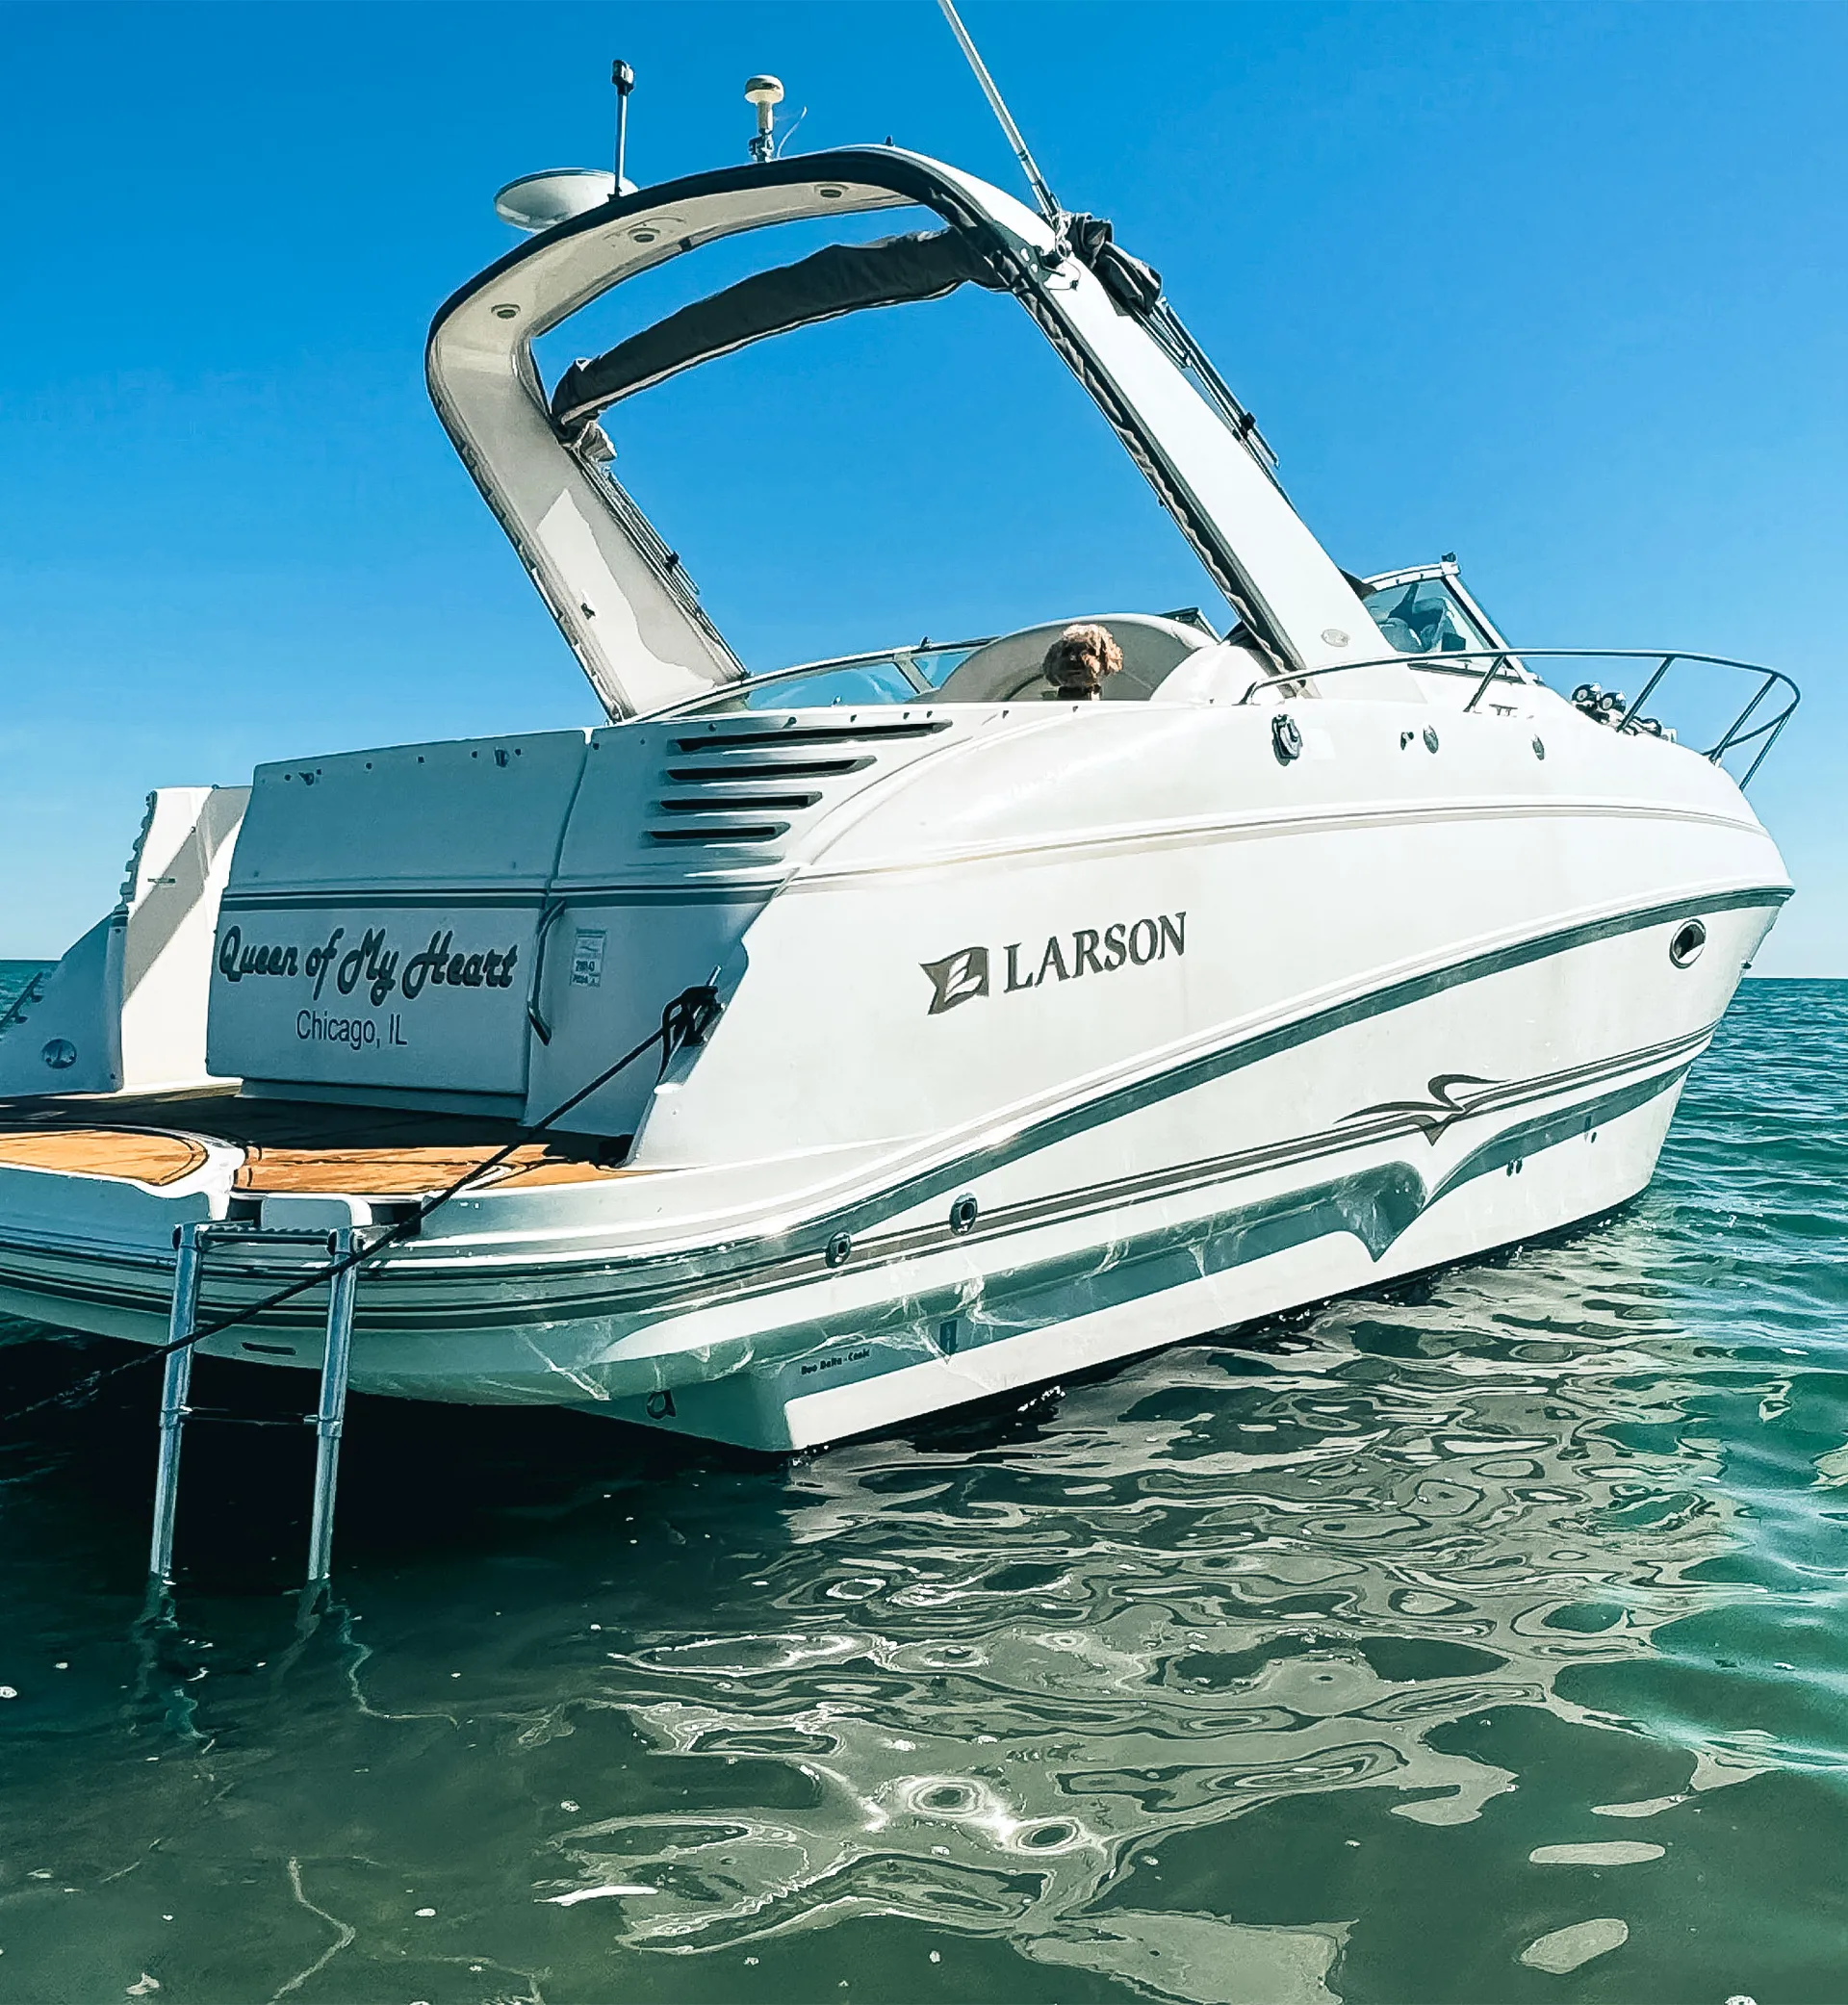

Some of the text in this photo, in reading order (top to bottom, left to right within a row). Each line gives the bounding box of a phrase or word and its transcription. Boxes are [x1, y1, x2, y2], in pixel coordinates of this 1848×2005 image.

[218, 925, 519, 1007] Queen of My Heart
[1003, 911, 1187, 993] LARSON
[296, 1010, 408, 1050] Chicago, IL
